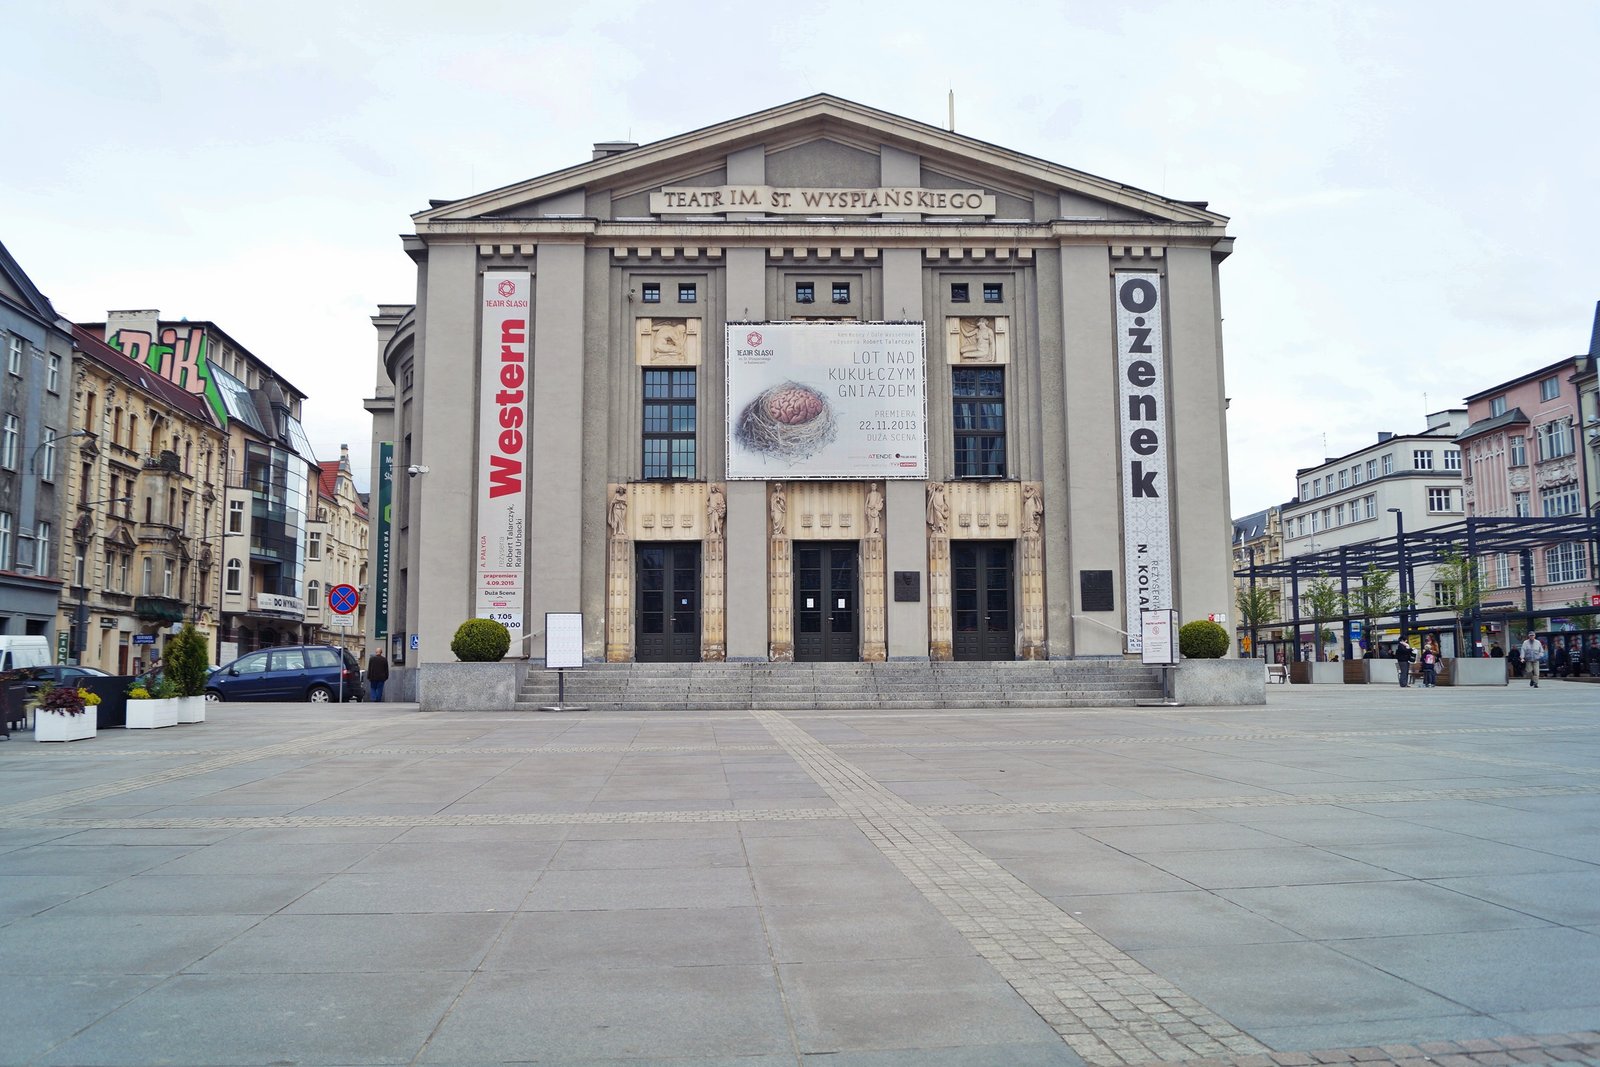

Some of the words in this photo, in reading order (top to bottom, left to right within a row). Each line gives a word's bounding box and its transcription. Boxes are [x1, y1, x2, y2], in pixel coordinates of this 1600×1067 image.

[664, 190, 725, 209] TEATR
[730, 189, 762, 206] IM.
[771, 191, 792, 208] ST.
[802, 188, 983, 209] WYSPIAŃSKIEGO
[853, 351, 881, 364] LOT
[887, 351, 915, 364] NAD
[828, 367, 916, 381] KUKUŁCZYM
[838, 384, 916, 398] GNIAZDEM
[1119, 278, 1160, 498] Ożenek
[490, 319, 525, 499] Western
[874, 410, 917, 418] PREMIERA
[859, 420, 917, 430] 22.11.2013
[890, 433, 917, 441] SCENA
[515, 518, 523, 547] Urbacki
[1137, 544, 1148, 559] N.
